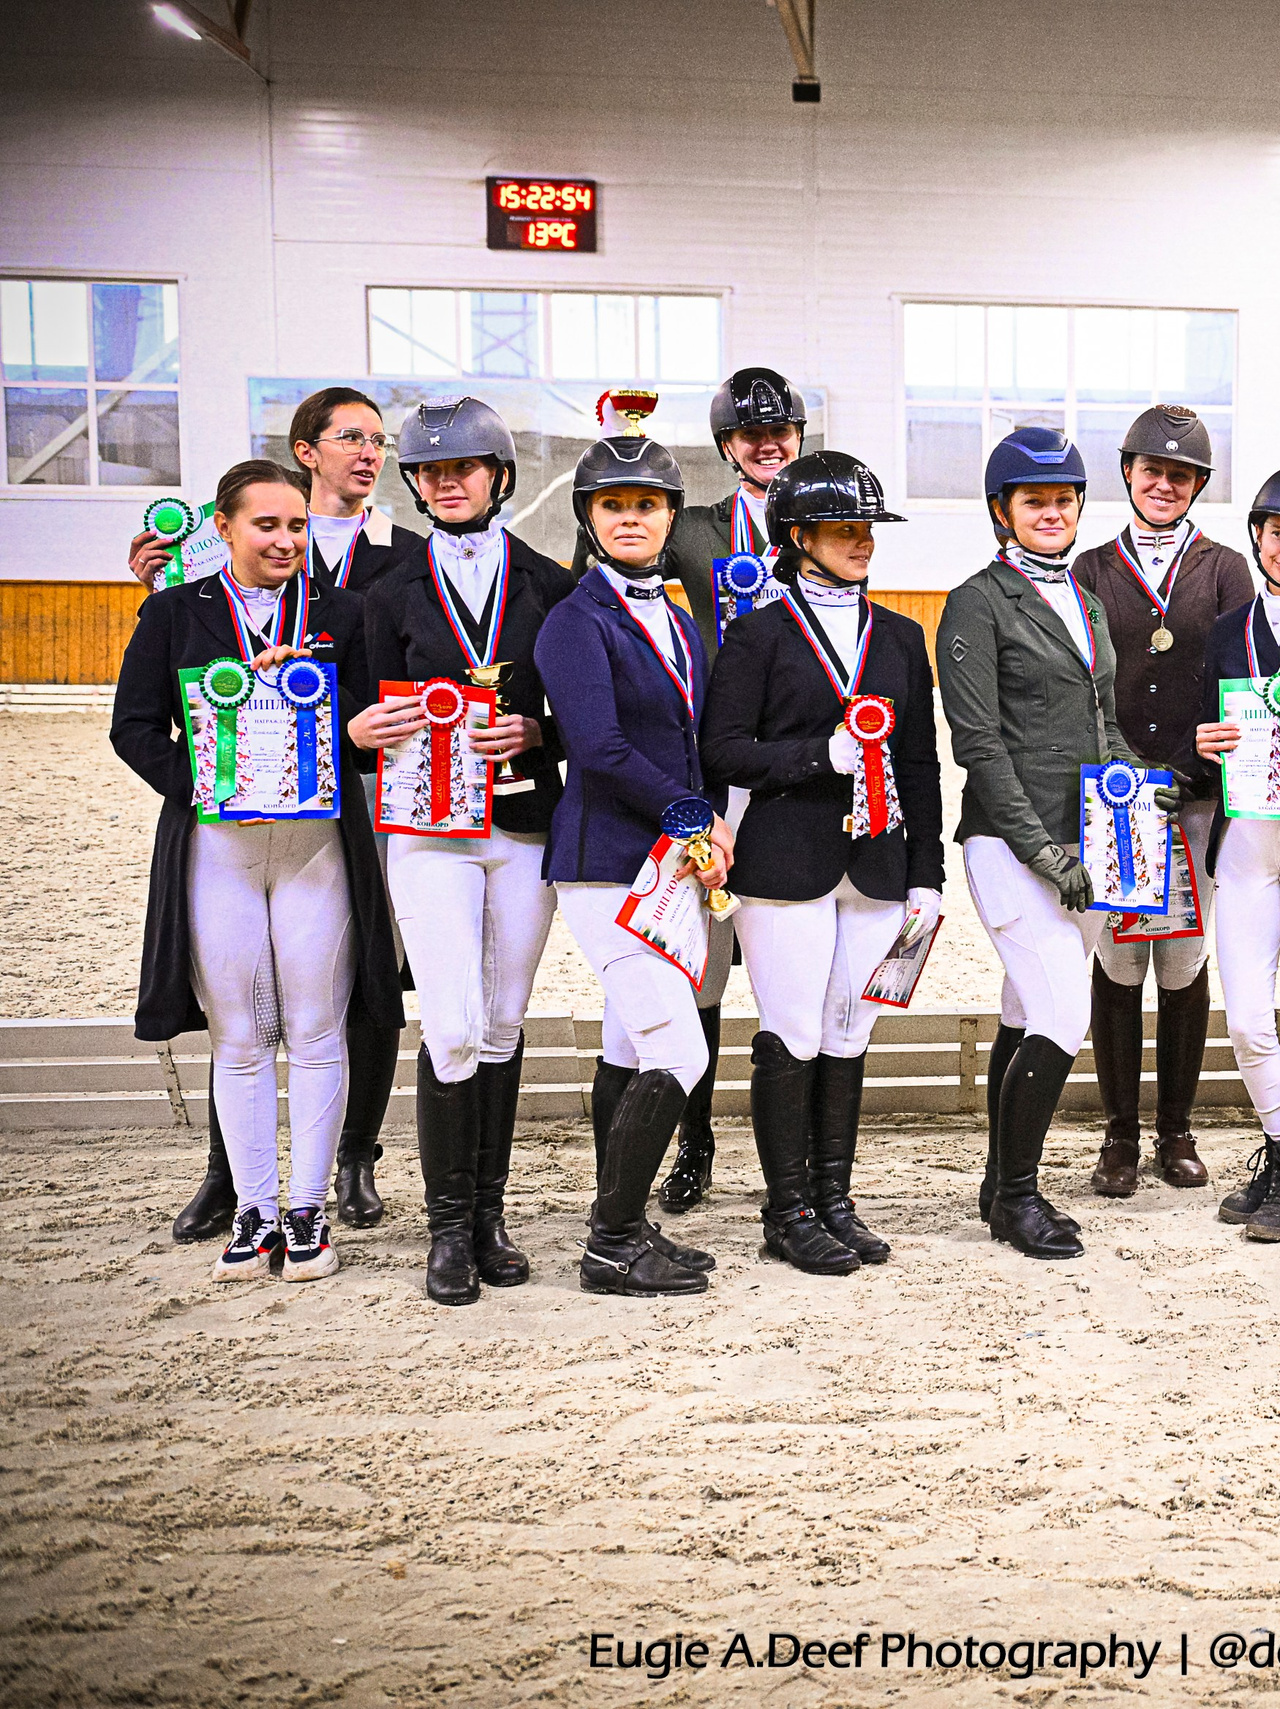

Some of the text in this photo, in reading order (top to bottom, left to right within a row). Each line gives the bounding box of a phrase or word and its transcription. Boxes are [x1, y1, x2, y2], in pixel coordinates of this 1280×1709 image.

[500, 184, 591, 211] 15:22:54
[244, 699, 290, 712] ДИПЛ
[1240, 709, 1272, 720] ДИП
[416, 820, 449, 828] КОНОРД
[651, 879, 679, 926] ДИПЛО
